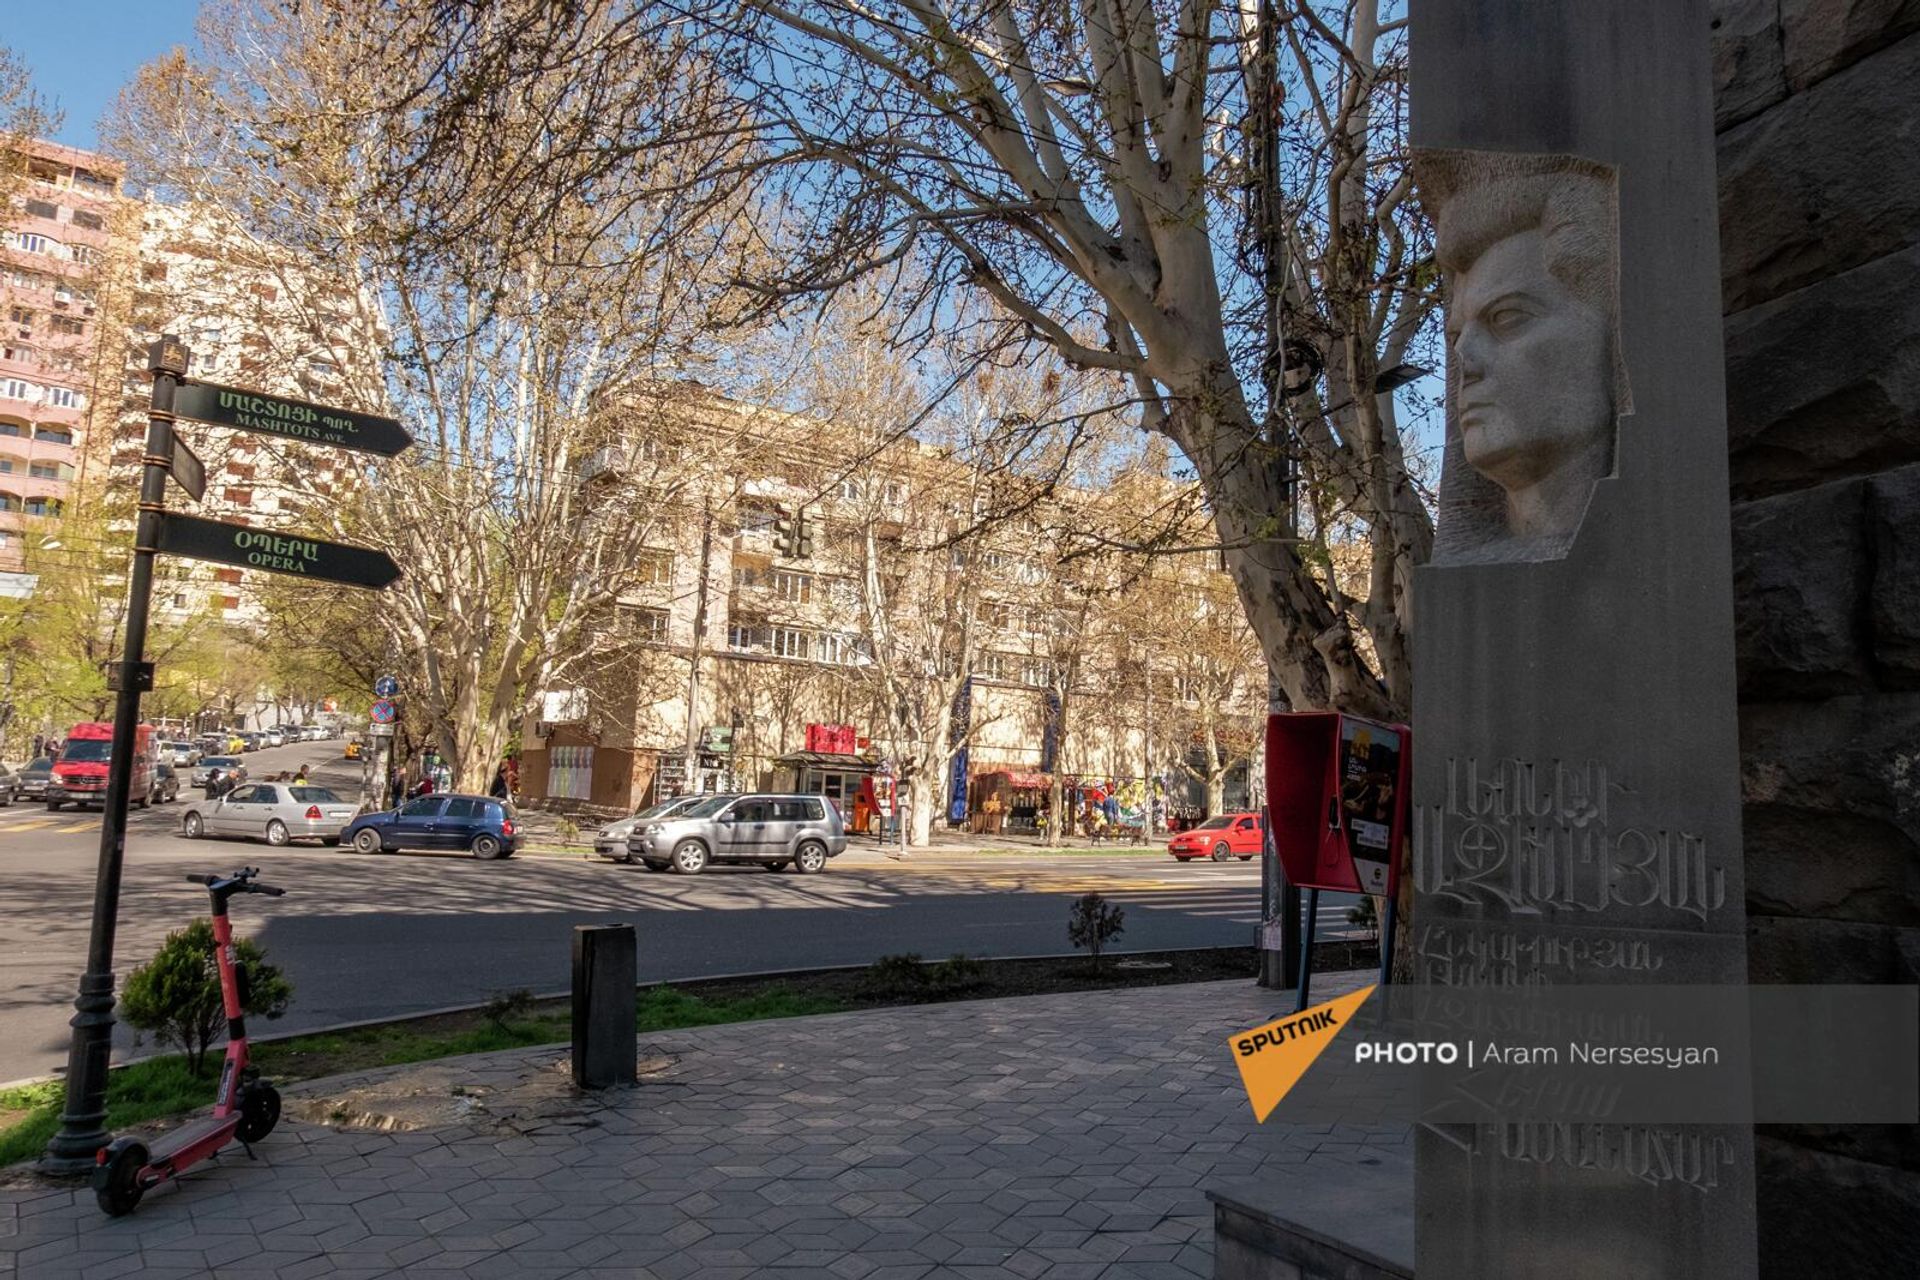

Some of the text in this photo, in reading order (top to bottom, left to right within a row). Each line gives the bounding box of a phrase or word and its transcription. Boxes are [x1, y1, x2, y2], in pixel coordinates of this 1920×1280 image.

[219, 392, 318, 423] ՄԱՇՏՈՑԻ
[236, 413, 346, 443] MASHTOTS AVE.
[234, 531, 319, 562] ՕՊԵՐԱ
[248, 552, 305, 573] OPERA
